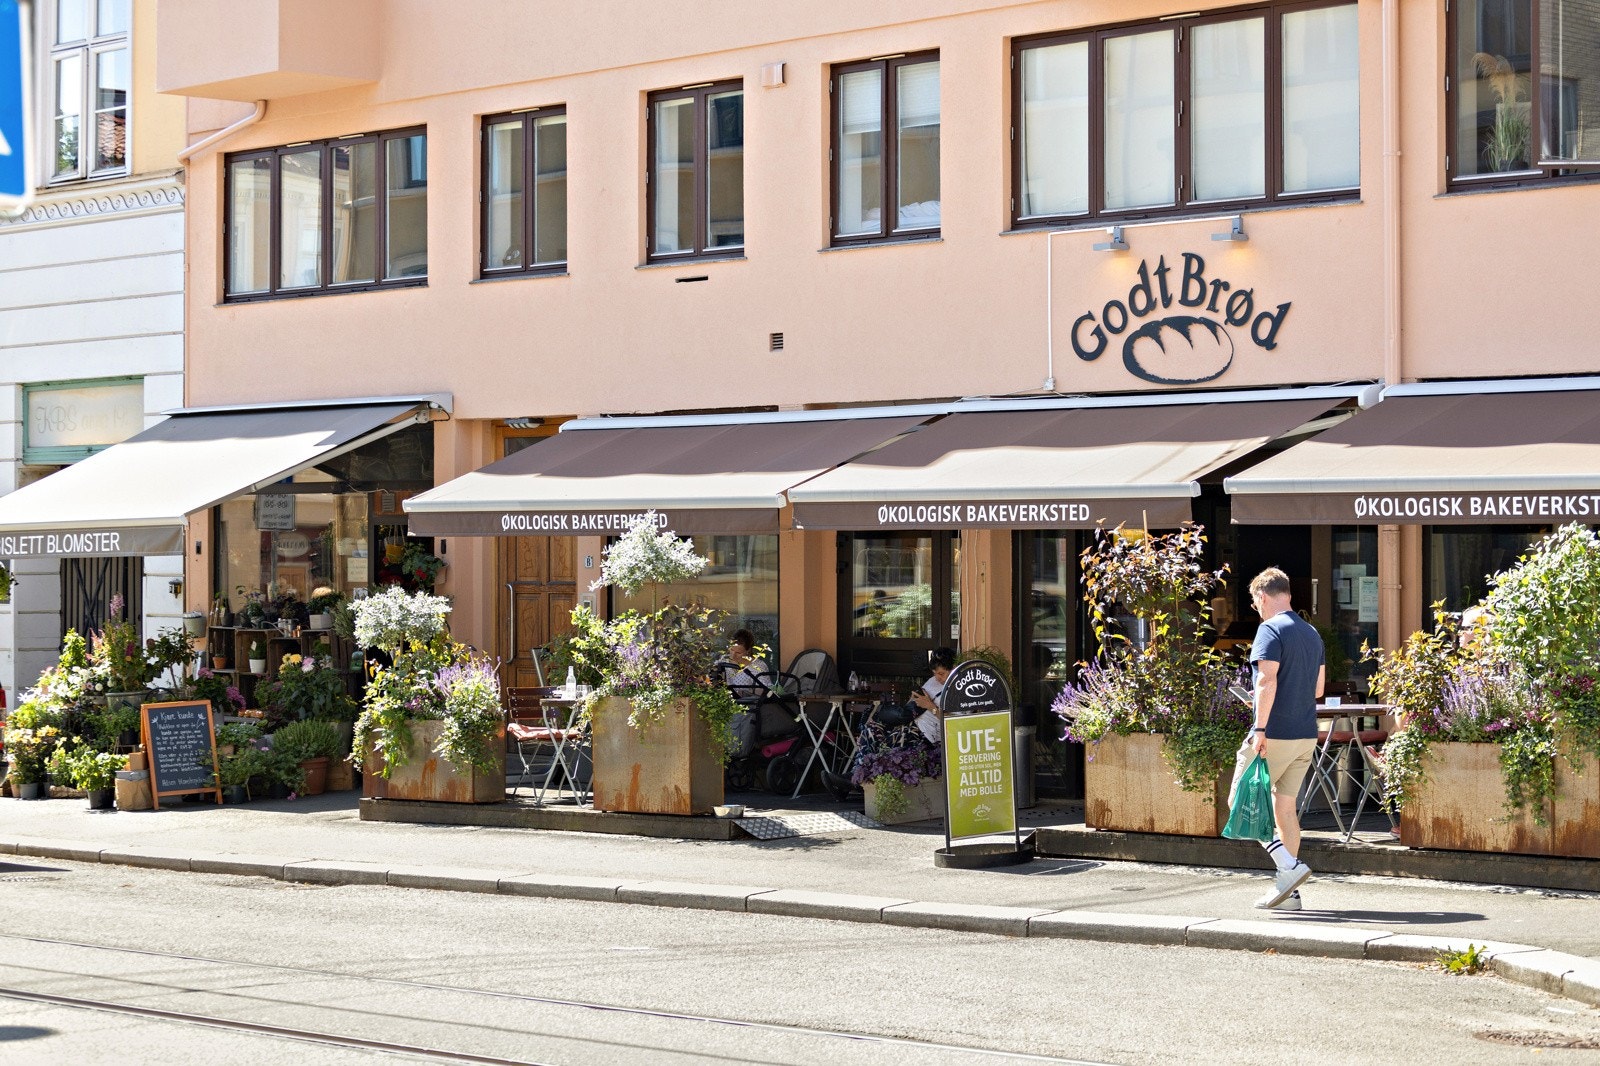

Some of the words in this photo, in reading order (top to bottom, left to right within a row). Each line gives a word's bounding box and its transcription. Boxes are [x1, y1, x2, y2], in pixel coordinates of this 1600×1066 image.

[1071, 255, 1173, 361] Godt
[1178, 252, 1292, 351] Brød
[877, 504, 962, 525] ØKOLOGISK
[966, 503, 1090, 522] BAKEVERKSTED
[1354, 495, 1464, 518] ØKOLOGISK
[1470, 495, 1600, 516] BAKEVERKST
[501, 513, 569, 531] ØKOLOGISK
[46, 532, 120, 553] BLOMSTER
[955, 669, 974, 691] Godt
[975, 669, 996, 687] Brød
[957, 728, 1002, 754] UTE-
[958, 751, 1001, 765] SERVERING
[960, 768, 1002, 787] ALLTID
[960, 787, 977, 798] MED
[979, 784, 1002, 796] BOLLE
